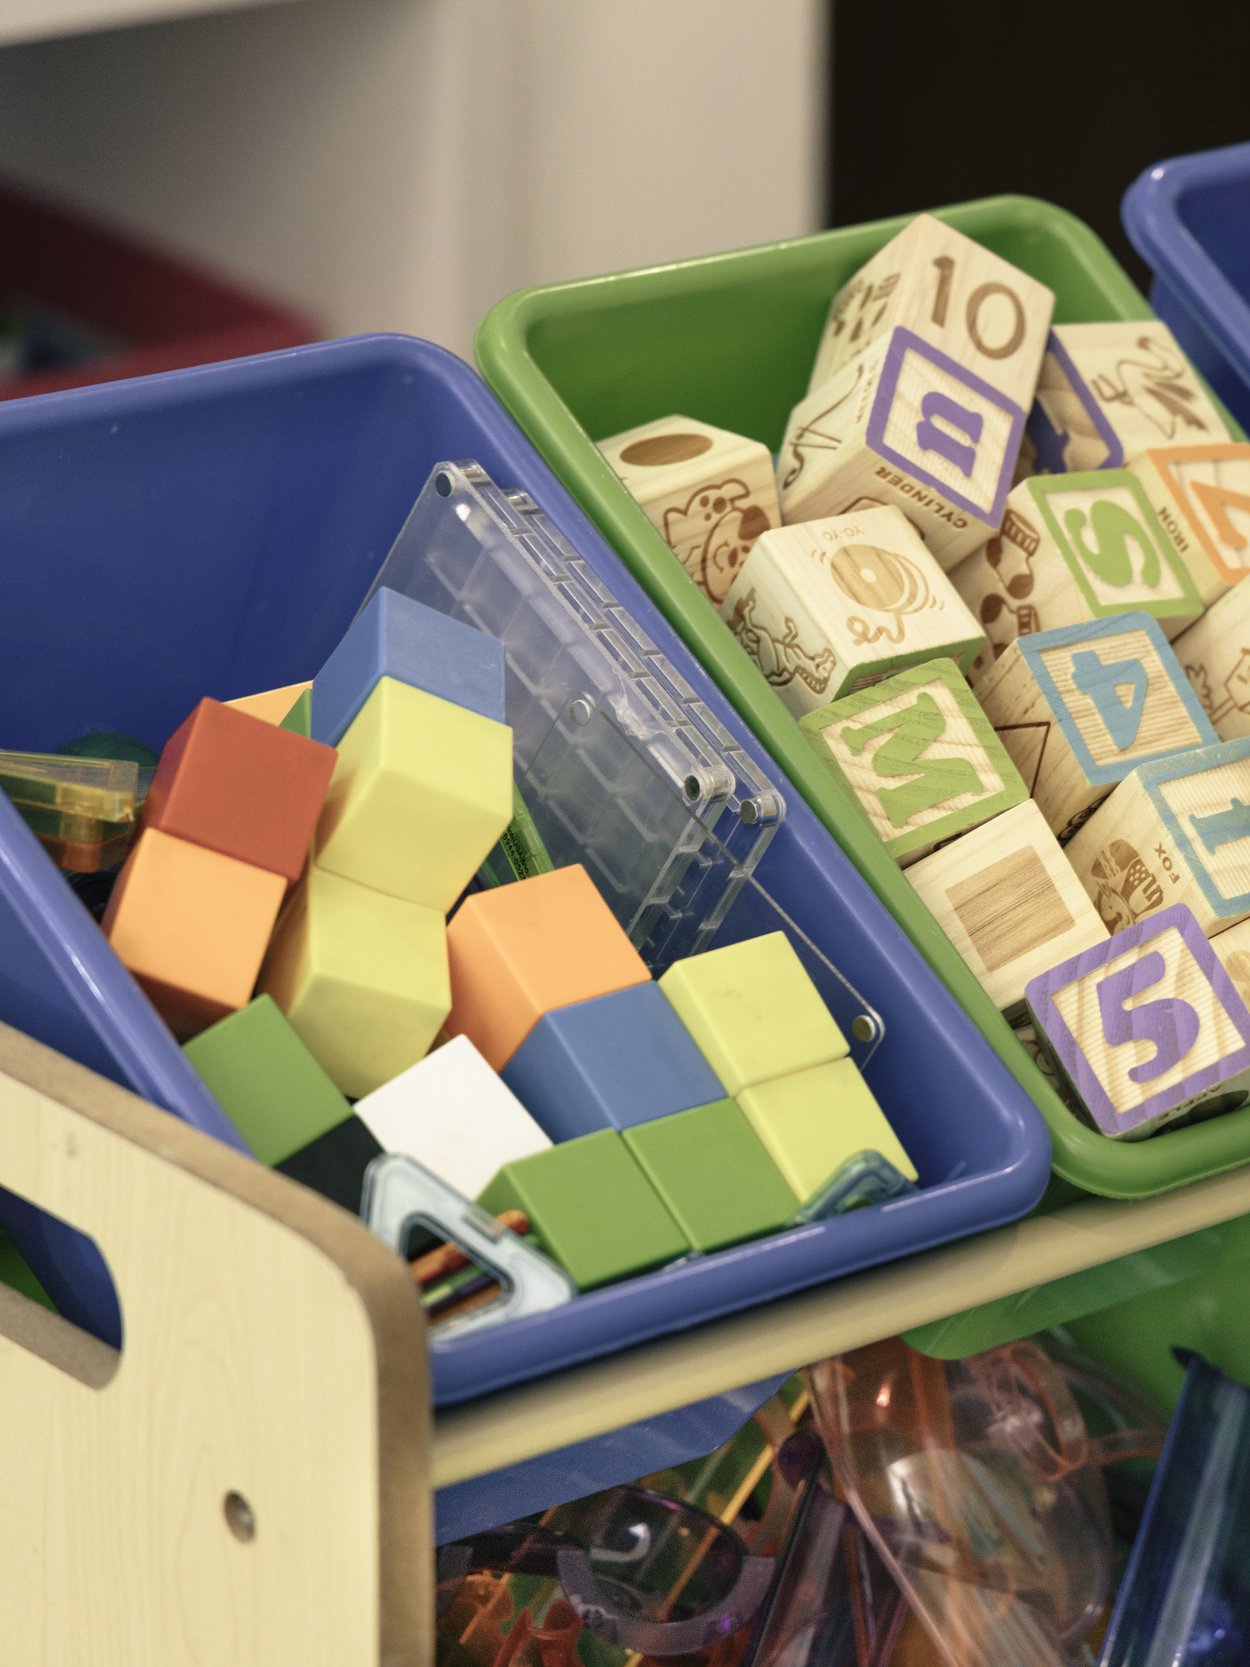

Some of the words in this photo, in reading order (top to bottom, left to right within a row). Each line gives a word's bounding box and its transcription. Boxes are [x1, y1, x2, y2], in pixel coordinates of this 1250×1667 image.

[931, 255, 1026, 359] 10
[916, 391, 984, 478] n
[875, 466, 968, 529] CYLINDER
[1157, 506, 1189, 553] IRON
[1064, 500, 1162, 588] S
[1071, 650, 1149, 751] 4
[840, 691, 984, 829] M
[1153, 842, 1180, 884] FOX
[1095, 951, 1200, 1085] 5
